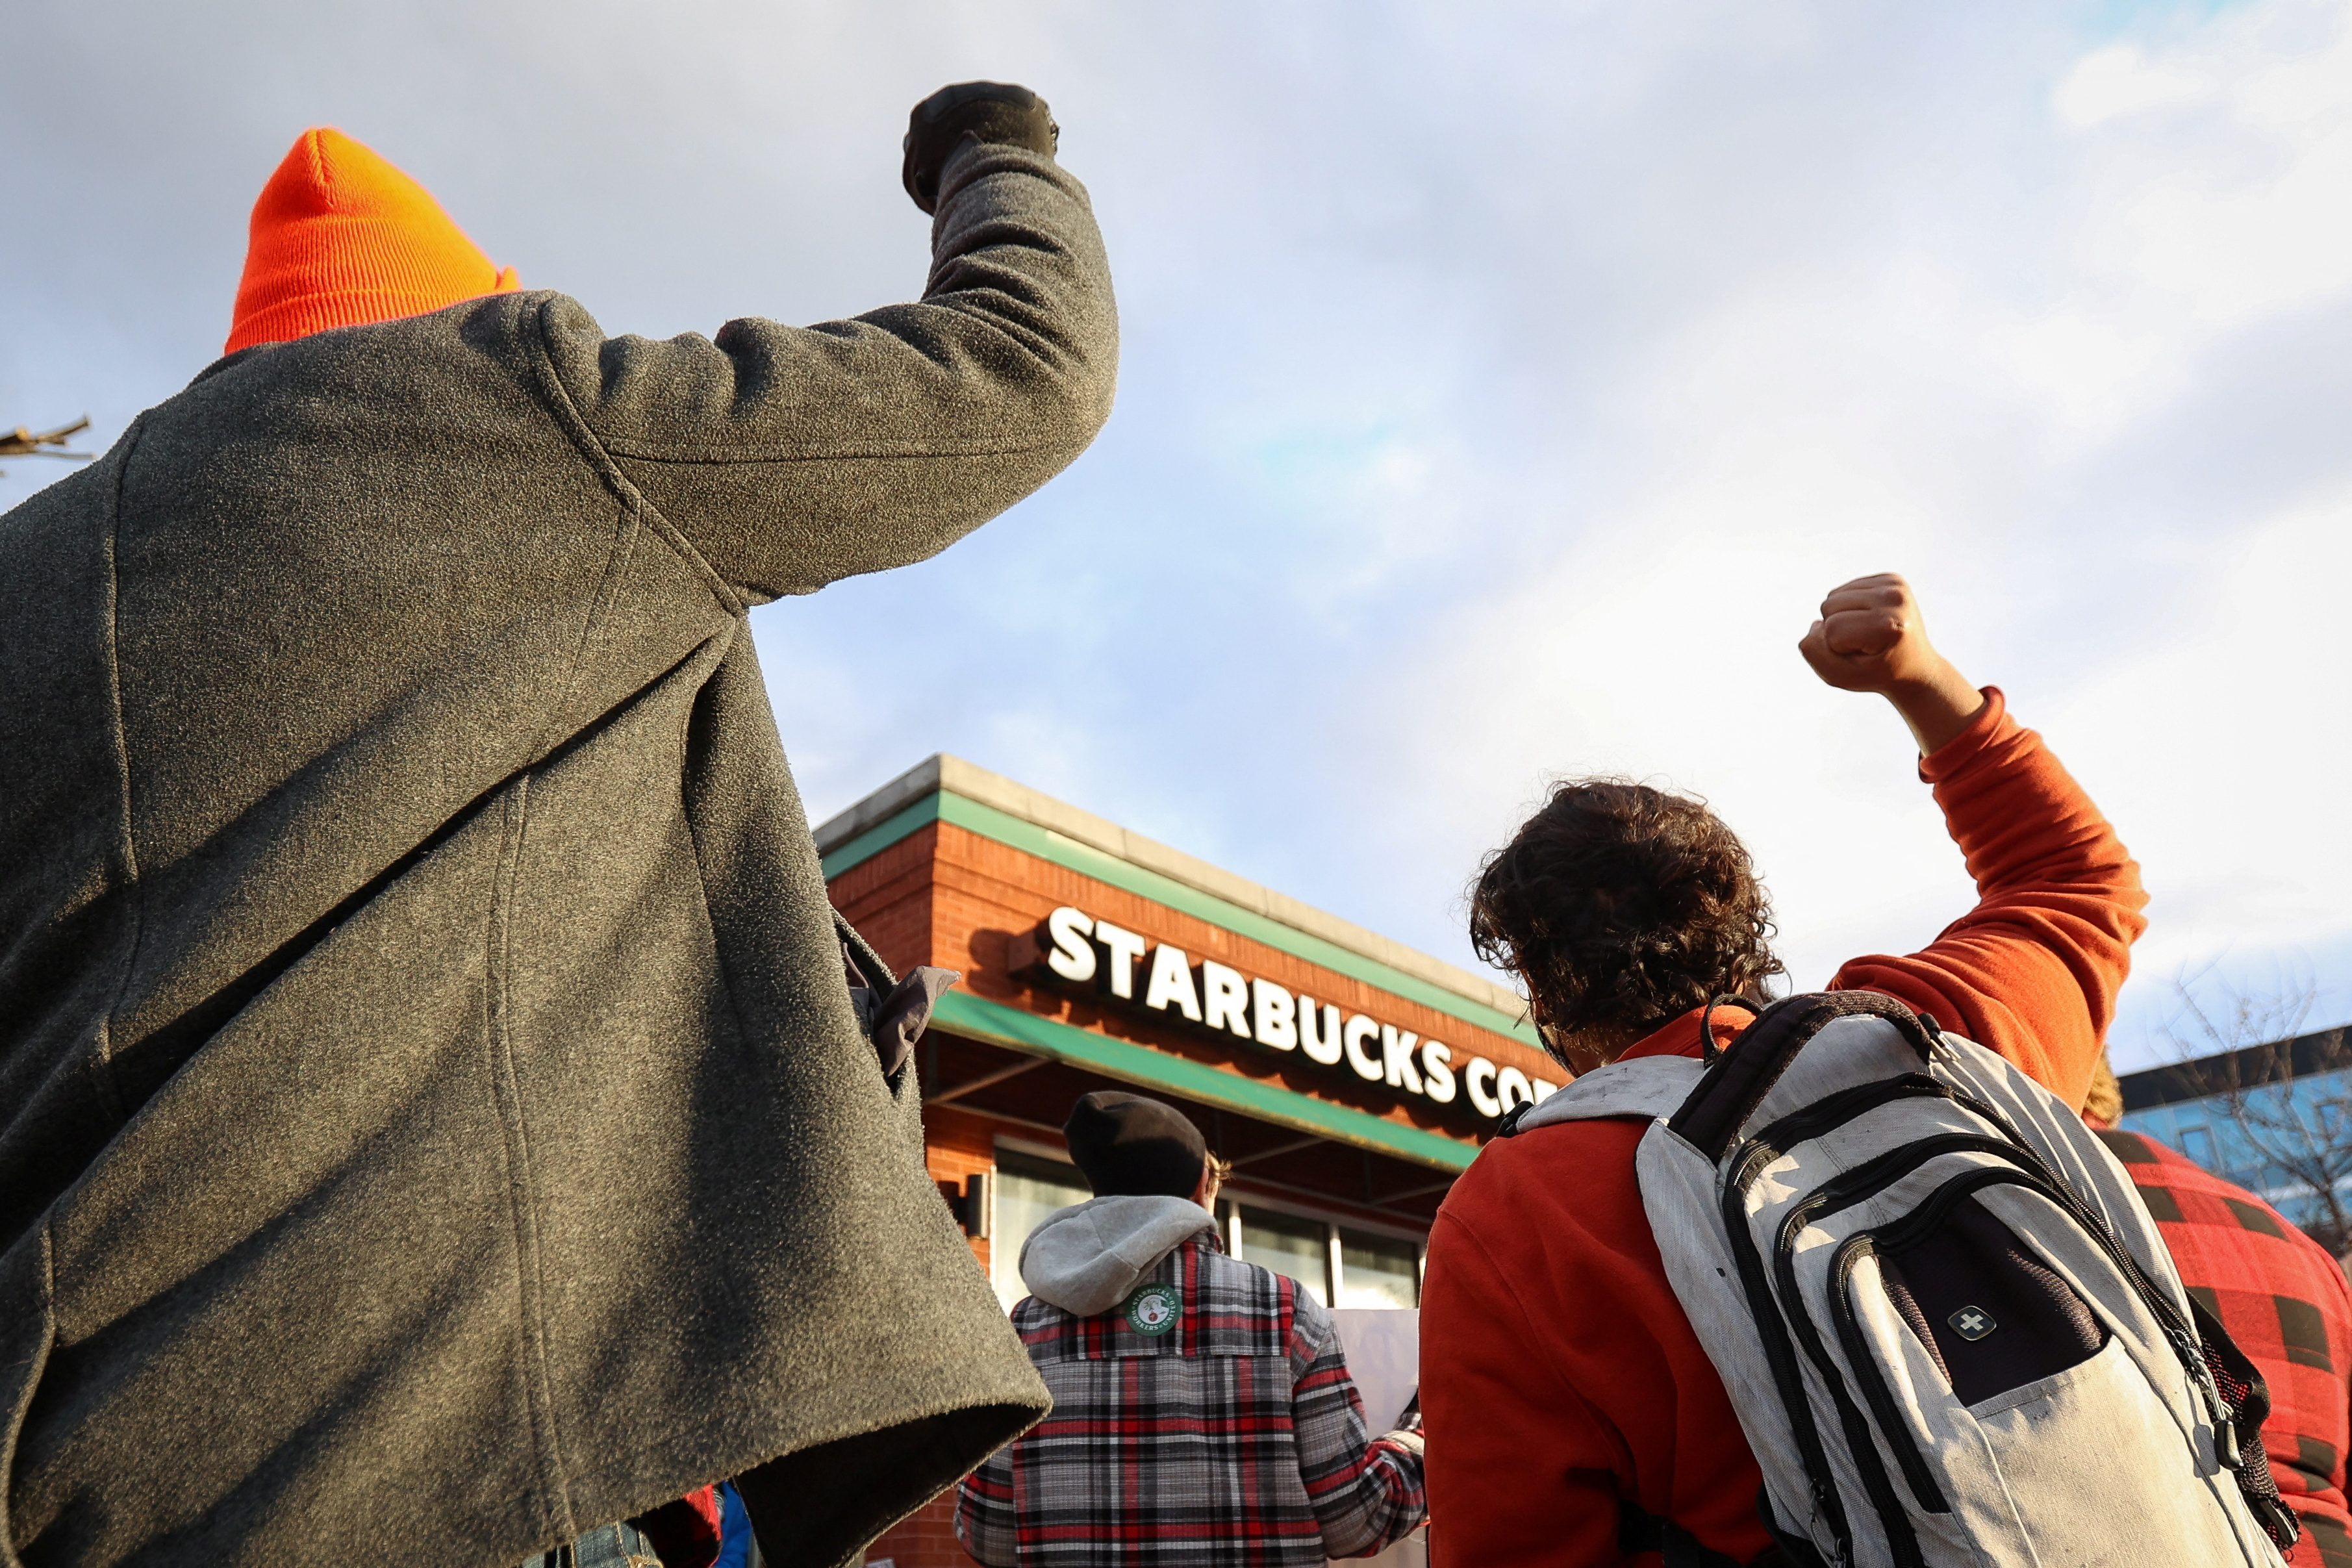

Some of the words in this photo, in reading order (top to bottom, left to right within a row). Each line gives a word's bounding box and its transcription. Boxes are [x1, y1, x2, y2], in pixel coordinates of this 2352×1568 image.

[1048, 906, 1456, 1104] STARBUCKS
[1132, 1289, 1170, 1306] STARBUCKS
[1132, 1310, 1159, 1331] WORKERS
[1162, 1300, 1176, 1326] UNITED
